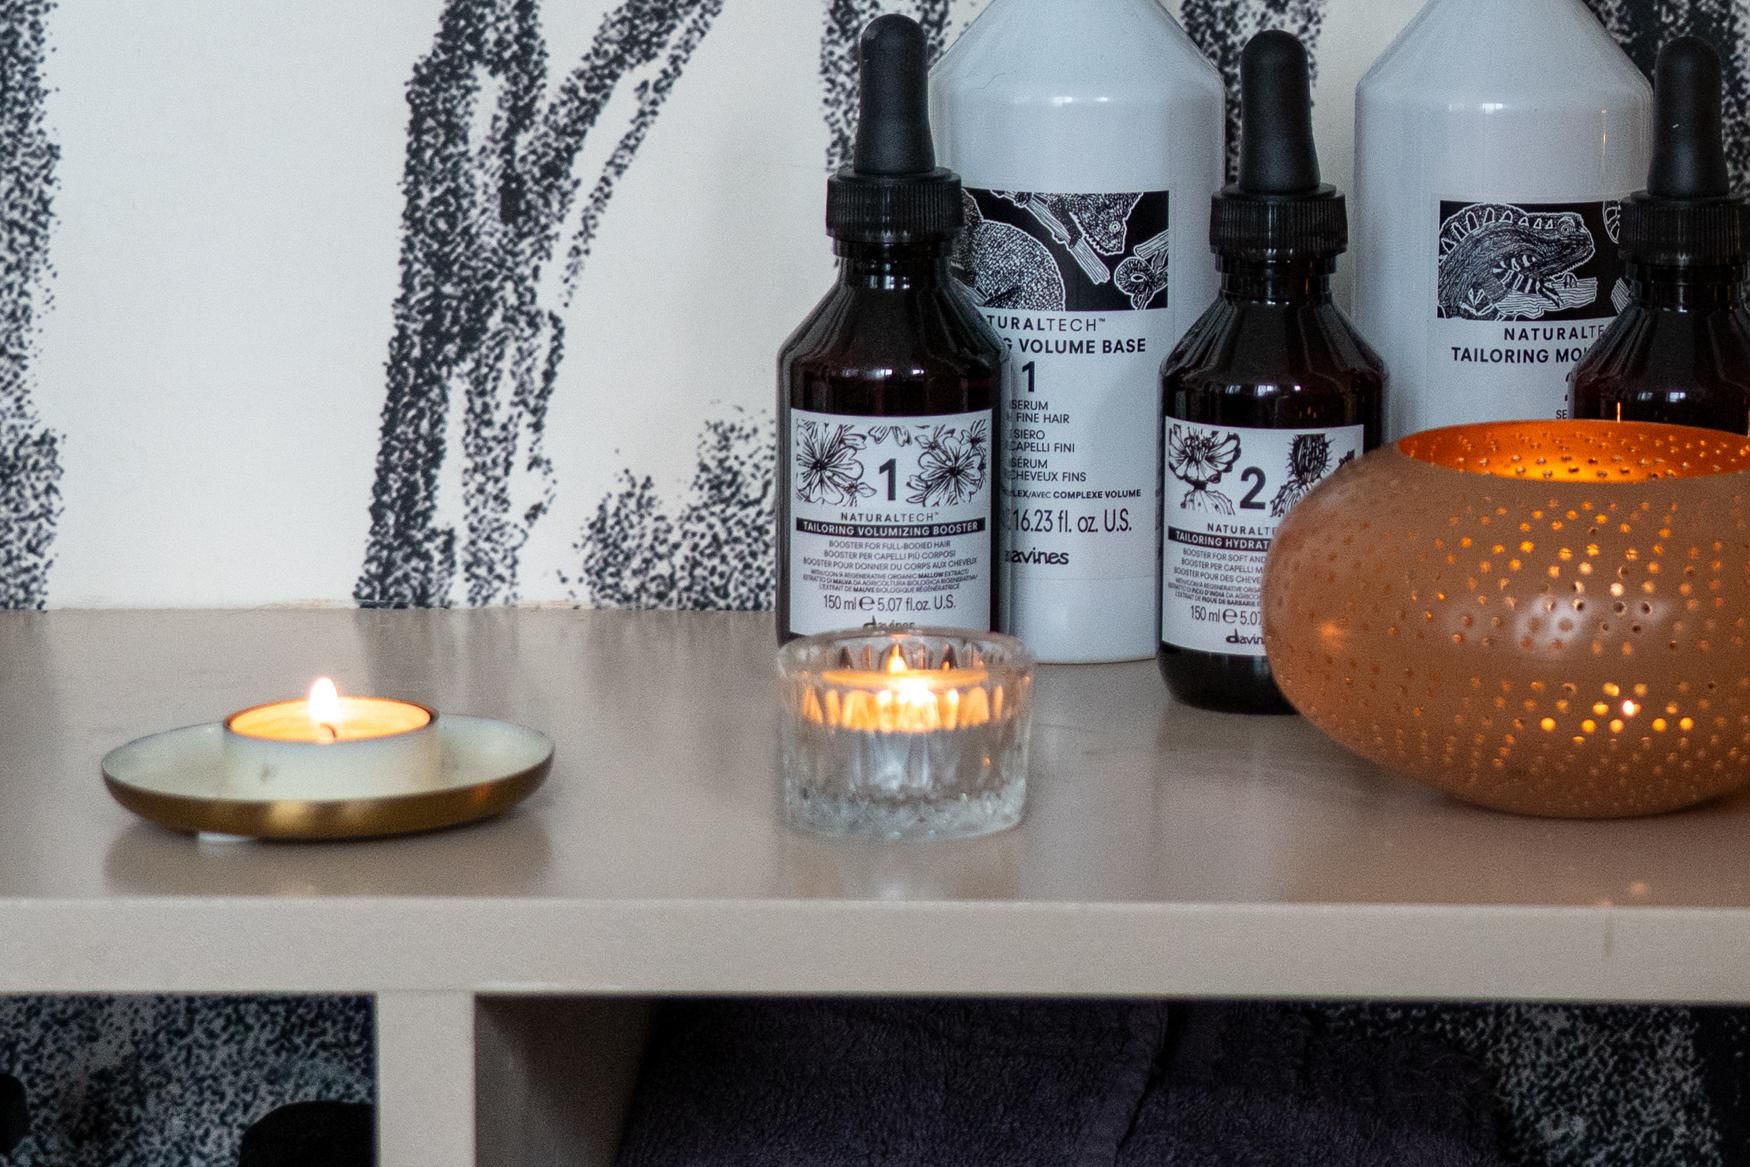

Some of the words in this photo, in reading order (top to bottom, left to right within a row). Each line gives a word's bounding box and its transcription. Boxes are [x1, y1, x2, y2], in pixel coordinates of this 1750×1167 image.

[1504, 324, 1604, 340] NATURALTE
[1019, 339, 1095, 353] VOLUME
[1103, 338, 1146, 353] BASE
[1452, 347, 1549, 363] TAILORING
[1022, 361, 1035, 392] 1
[1011, 400, 1048, 410] SERUM
[1016, 413, 1039, 423] FINE
[1044, 414, 1069, 423] HAIR
[1014, 429, 1045, 439] SIERO
[1054, 443, 1074, 452] FINI
[1011, 456, 1047, 468] SÉRUM
[879, 458, 896, 501] 1
[1062, 472, 1086, 482] FINS
[1105, 489, 1141, 497] VOLUME
[1240, 466, 1265, 509] 2
[1013, 509, 1052, 532] 16.23
[1058, 510, 1071, 532] fl.
[1078, 516, 1098, 532] oz.
[1104, 508, 1132, 532] U.S.
[803, 521, 854, 535] TAILORING
[858, 526, 929, 537] VOLUMIZING
[934, 522, 977, 535] BOOSTER
[829, 540, 863, 549] BOOSTER
[865, 542, 881, 550] FOR
[882, 541, 931, 550] FULL-BODIED
[934, 540, 950, 548] HAIR
[1175, 531, 1222, 546] TAILORING
[1226, 537, 1269, 549] HYDRAT
[824, 550, 857, 559] BOOSTER
[859, 552, 872, 560] PER
[874, 552, 906, 560] CAPELLI
[922, 550, 955, 559] CORPOSI
[1010, 547, 1069, 564] avines
[1183, 548, 1211, 559] BOOSTER
[1212, 552, 1227, 561] FOR
[1228, 554, 1248, 562] SOFT
[804, 557, 831, 568] BOOSTER
[833, 561, 853, 569] POUR
[855, 562, 888, 570] DONNER
[890, 562, 901, 570] DU
[904, 561, 930, 570] CORPS
[932, 560, 946, 568] AUX
[948, 557, 977, 567] CHEVEUX
[1182, 558, 1209, 569] BOOSTER
[1210, 561, 1222, 570] PER
[1224, 564, 1253, 573] CAPELLI
[1201, 571, 1218, 580] POUR
[1220, 574, 1233, 582] DES
[824, 594, 841, 609] 150
[844, 598, 856, 610] ml
[878, 597, 902, 611] 5.07
[934, 594, 956, 610] U.S.
[1190, 604, 1206, 621] 150
[1209, 609, 1219, 622] ml
